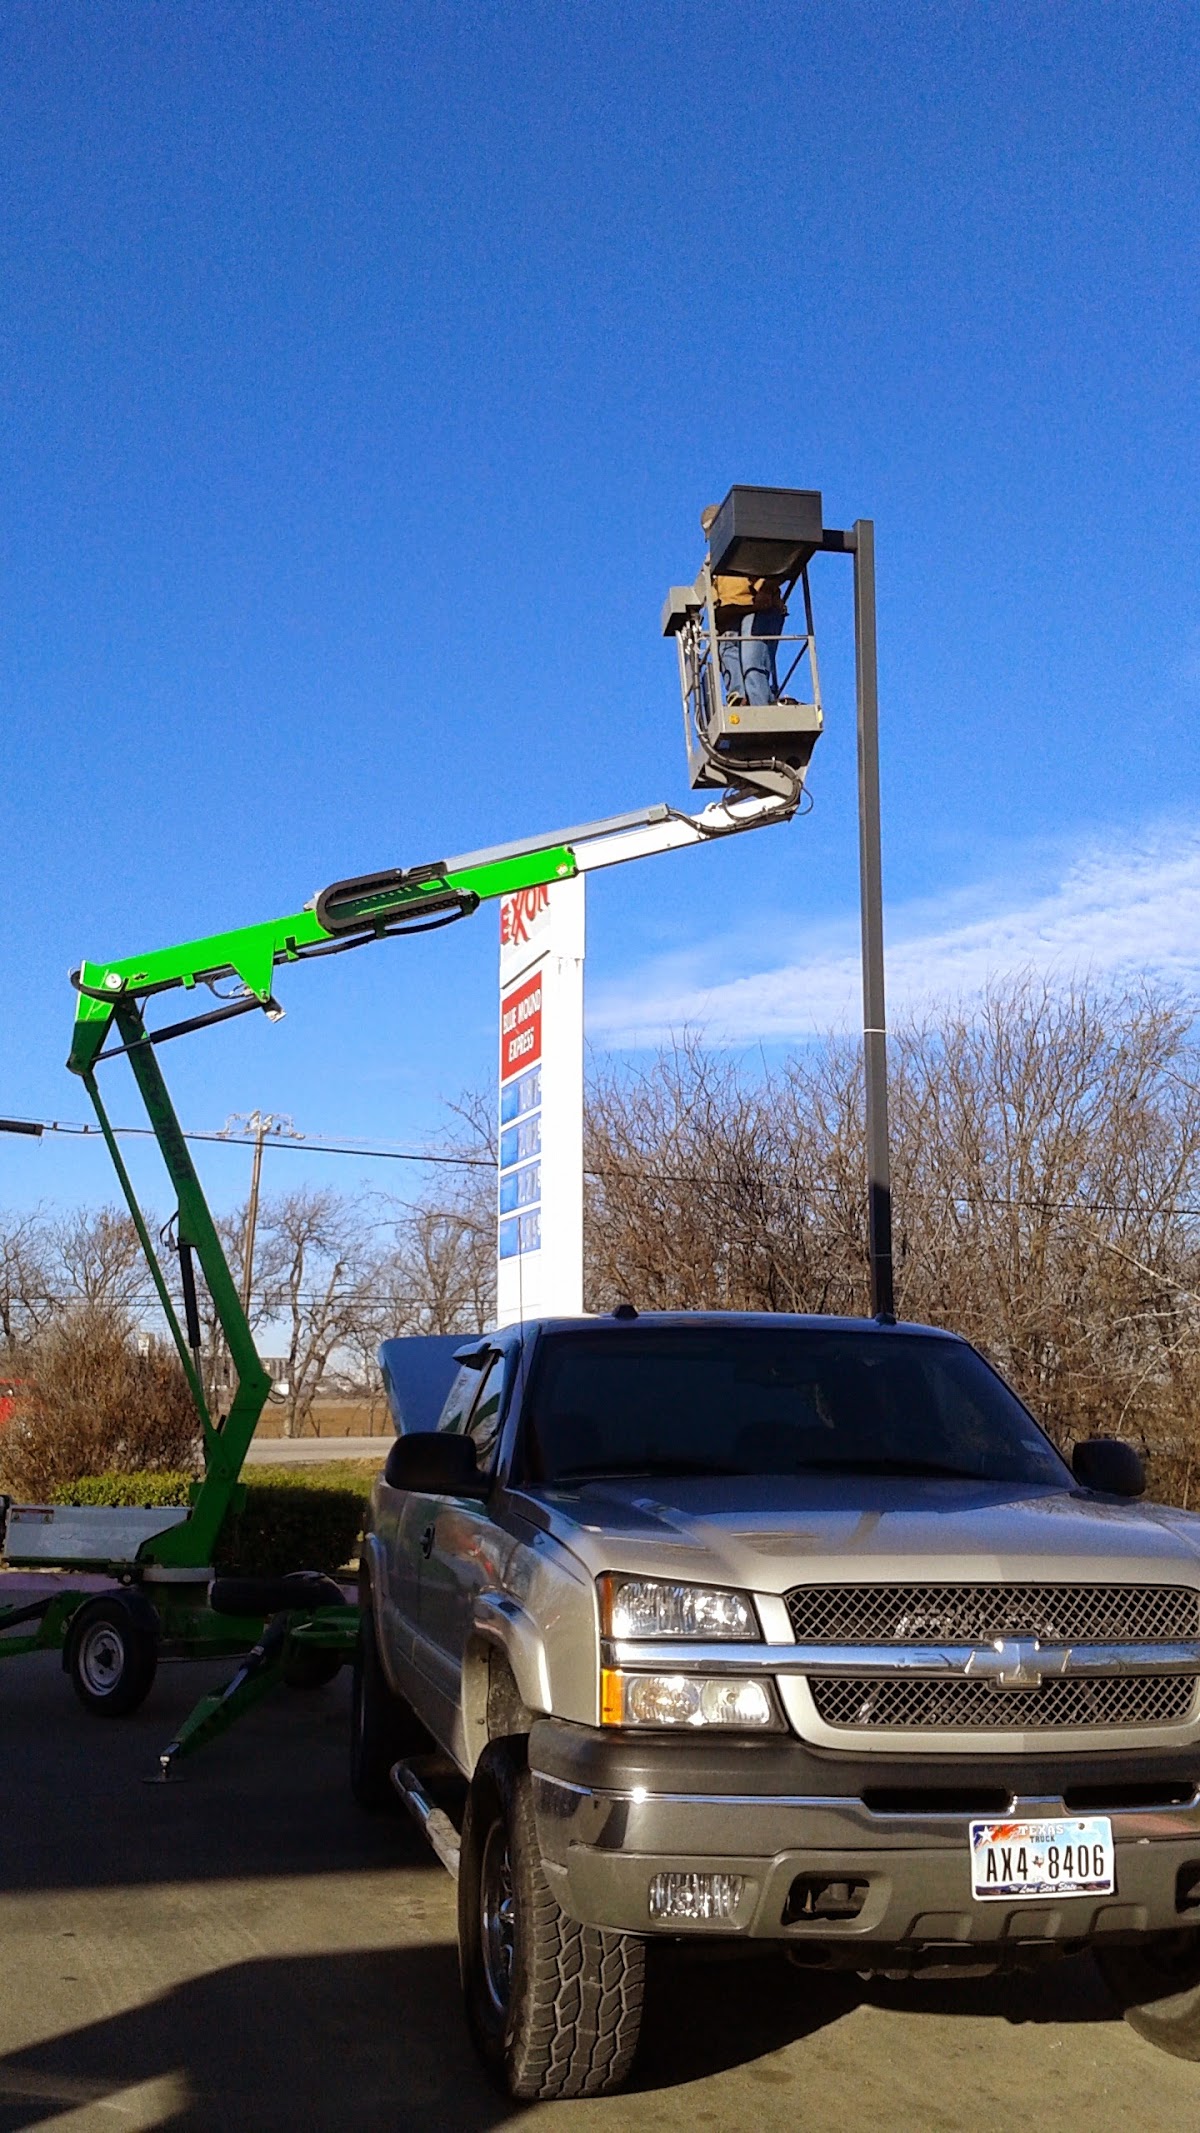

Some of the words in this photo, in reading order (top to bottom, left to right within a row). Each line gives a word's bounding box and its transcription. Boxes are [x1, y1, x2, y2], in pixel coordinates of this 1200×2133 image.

[500, 884, 550, 946] EXXON
[503, 1006, 517, 1035] BLUE
[517, 988, 541, 1024] MOUND
[508, 1026, 534, 1063] EXPRESS
[1018, 1825, 1064, 1836] TEXAS
[1030, 1835, 1056, 1843] TRUCK
[986, 1847, 1028, 1882] AX4
[1048, 1844, 1104, 1879] 8406
